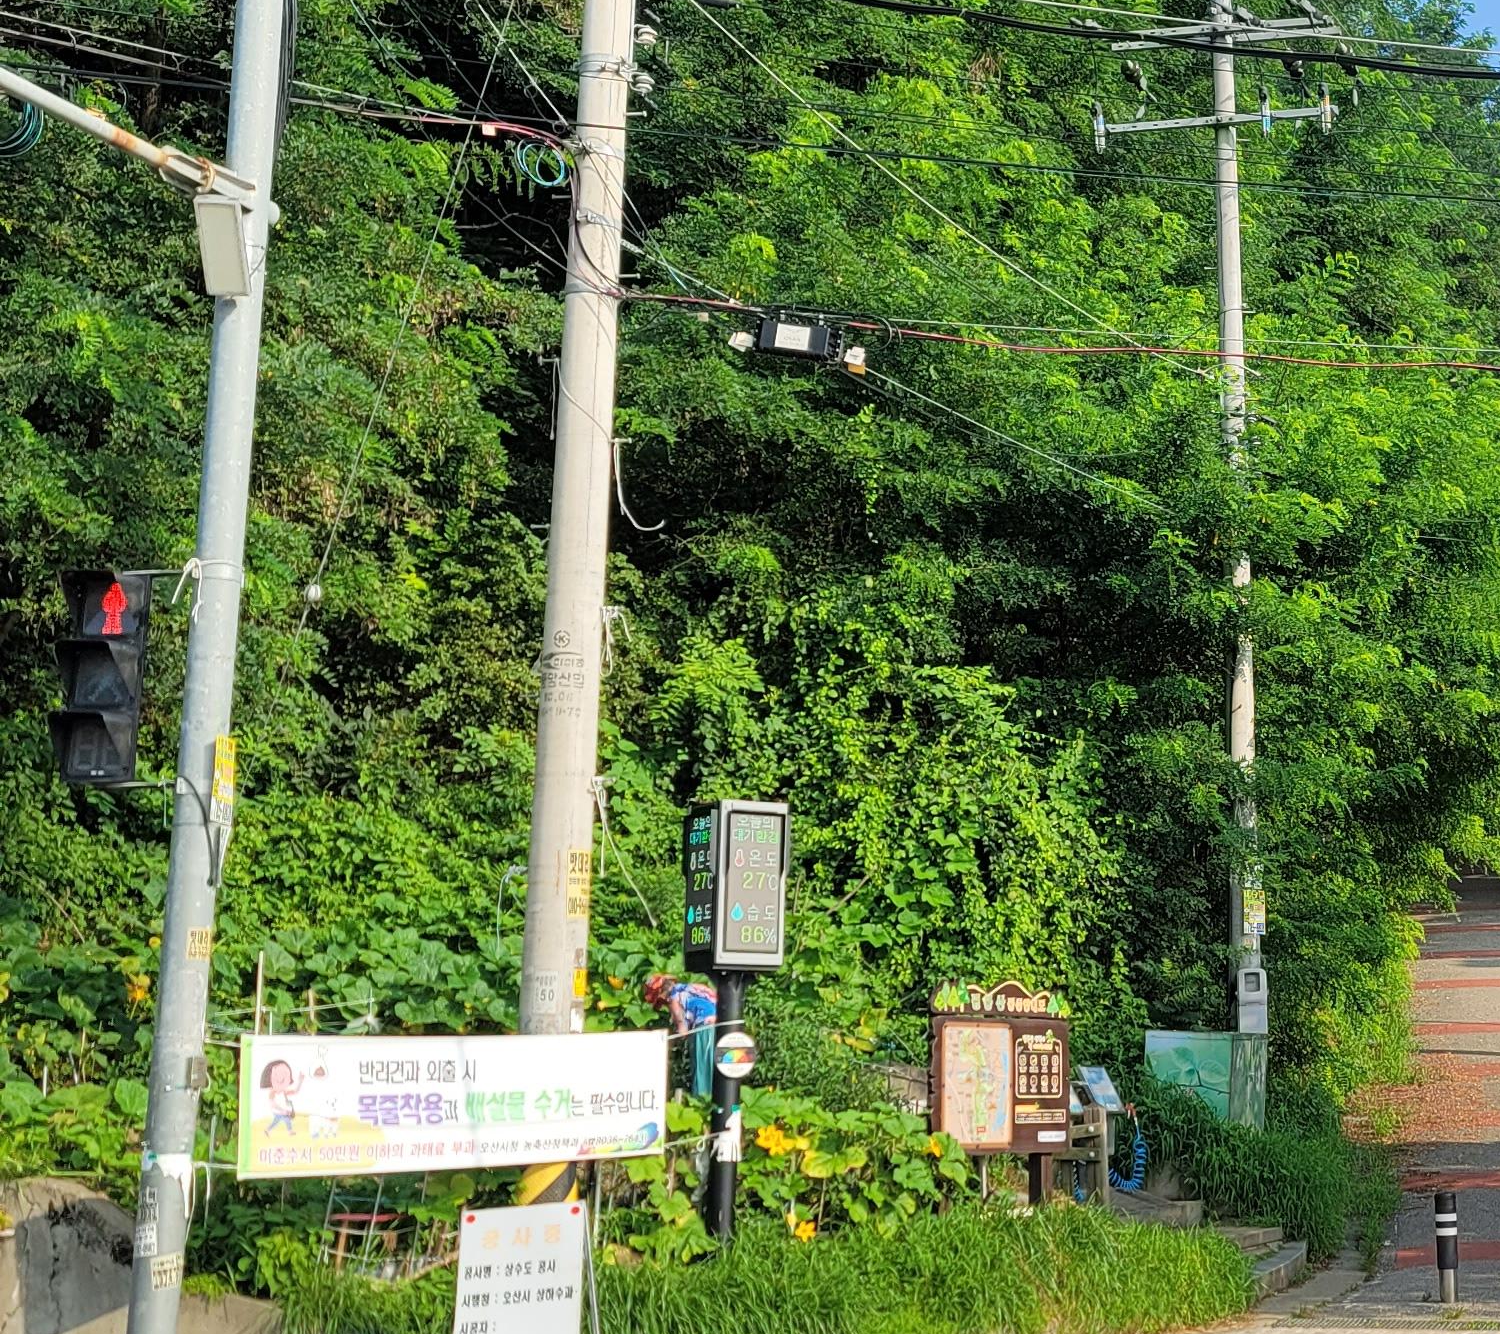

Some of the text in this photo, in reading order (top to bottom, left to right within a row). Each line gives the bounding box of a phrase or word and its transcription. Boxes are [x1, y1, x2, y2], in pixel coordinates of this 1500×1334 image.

[747, 903, 776, 921] 습도
[740, 925, 777, 945] 86%
[426, 1059, 456, 1083] 외출
[462, 1059, 477, 1083] 시
[358, 1091, 459, 1126] 목줄착용과
[534, 1087, 585, 1118] 수거는
[590, 1089, 660, 1115] 필수입니다.
[503, 1288, 531, 1306] 오산시
